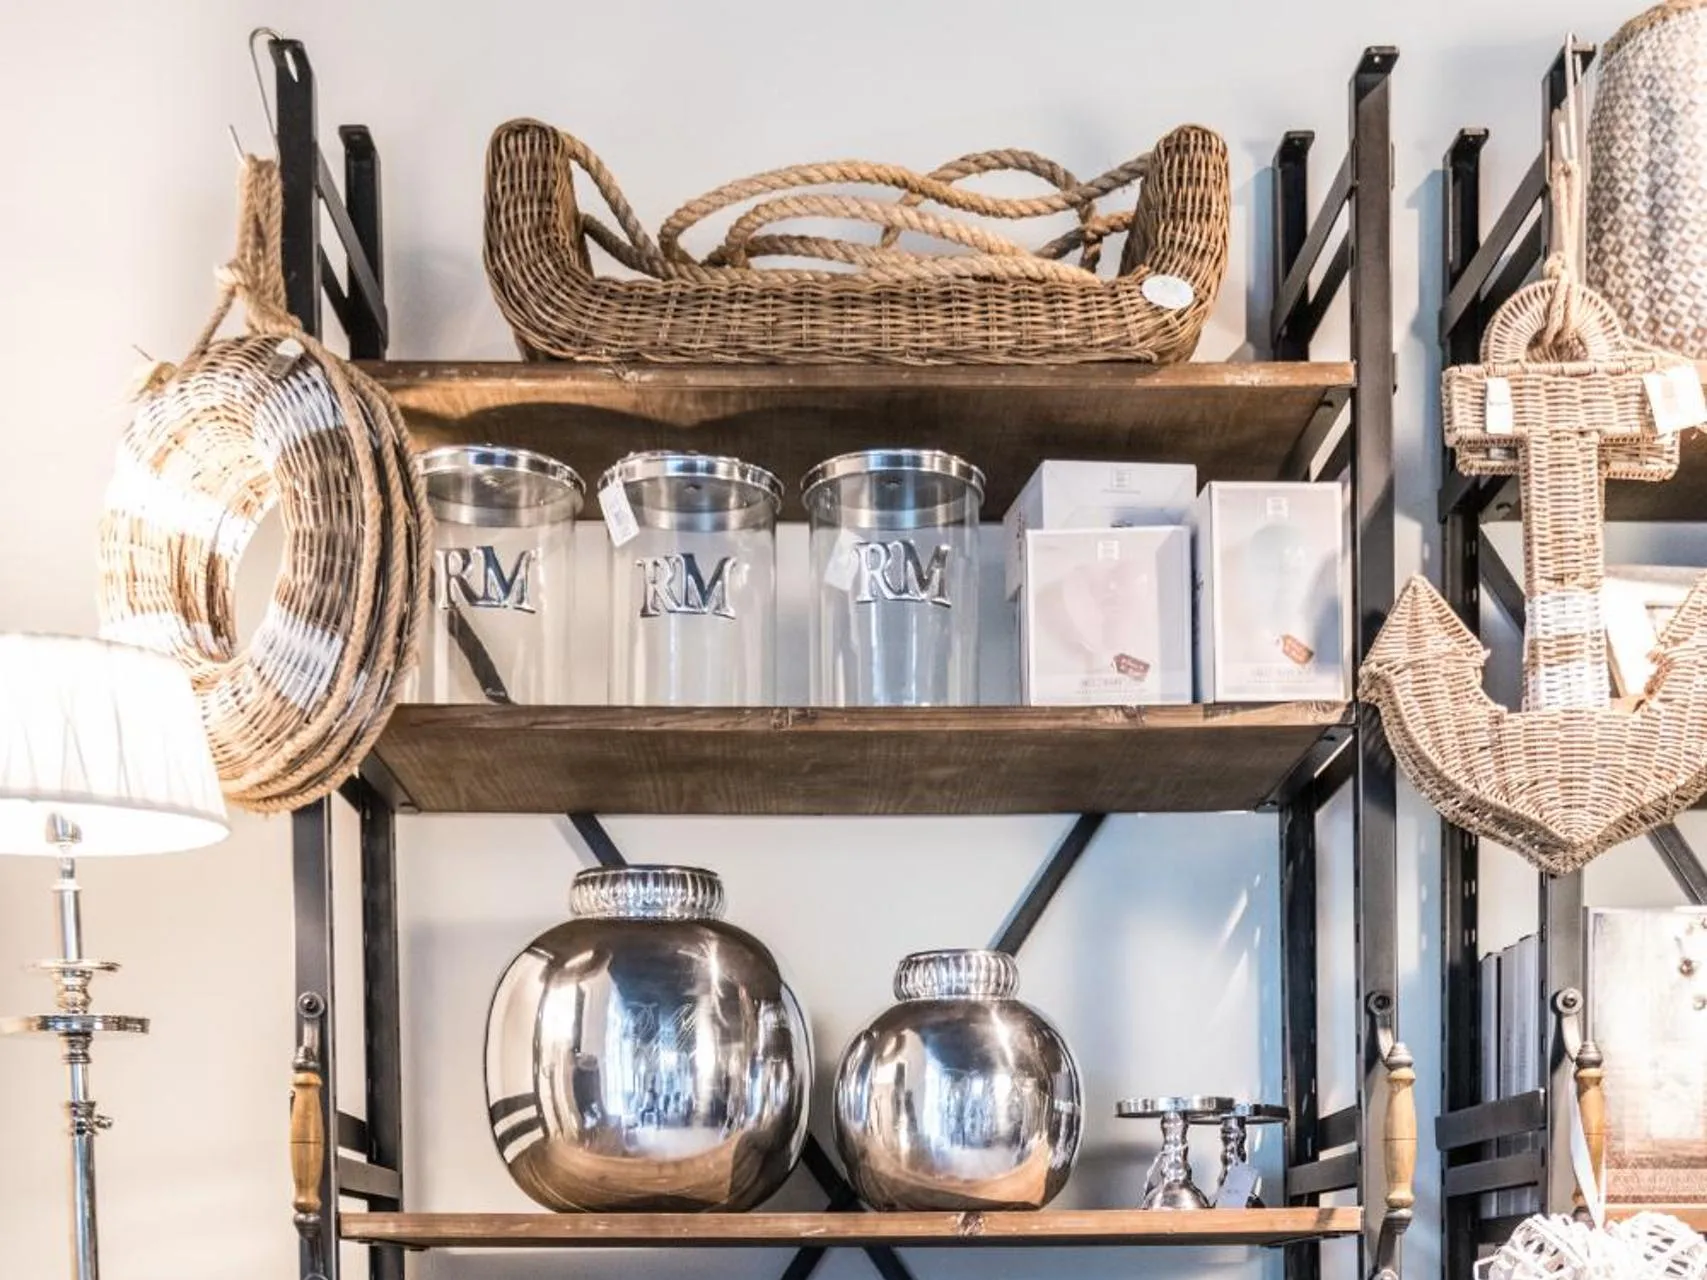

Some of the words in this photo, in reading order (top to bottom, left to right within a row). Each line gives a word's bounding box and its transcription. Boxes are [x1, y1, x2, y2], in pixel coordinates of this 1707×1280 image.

[435, 545, 538, 614] RM
[636, 552, 738, 620] RM
[854, 540, 951, 608] RM
